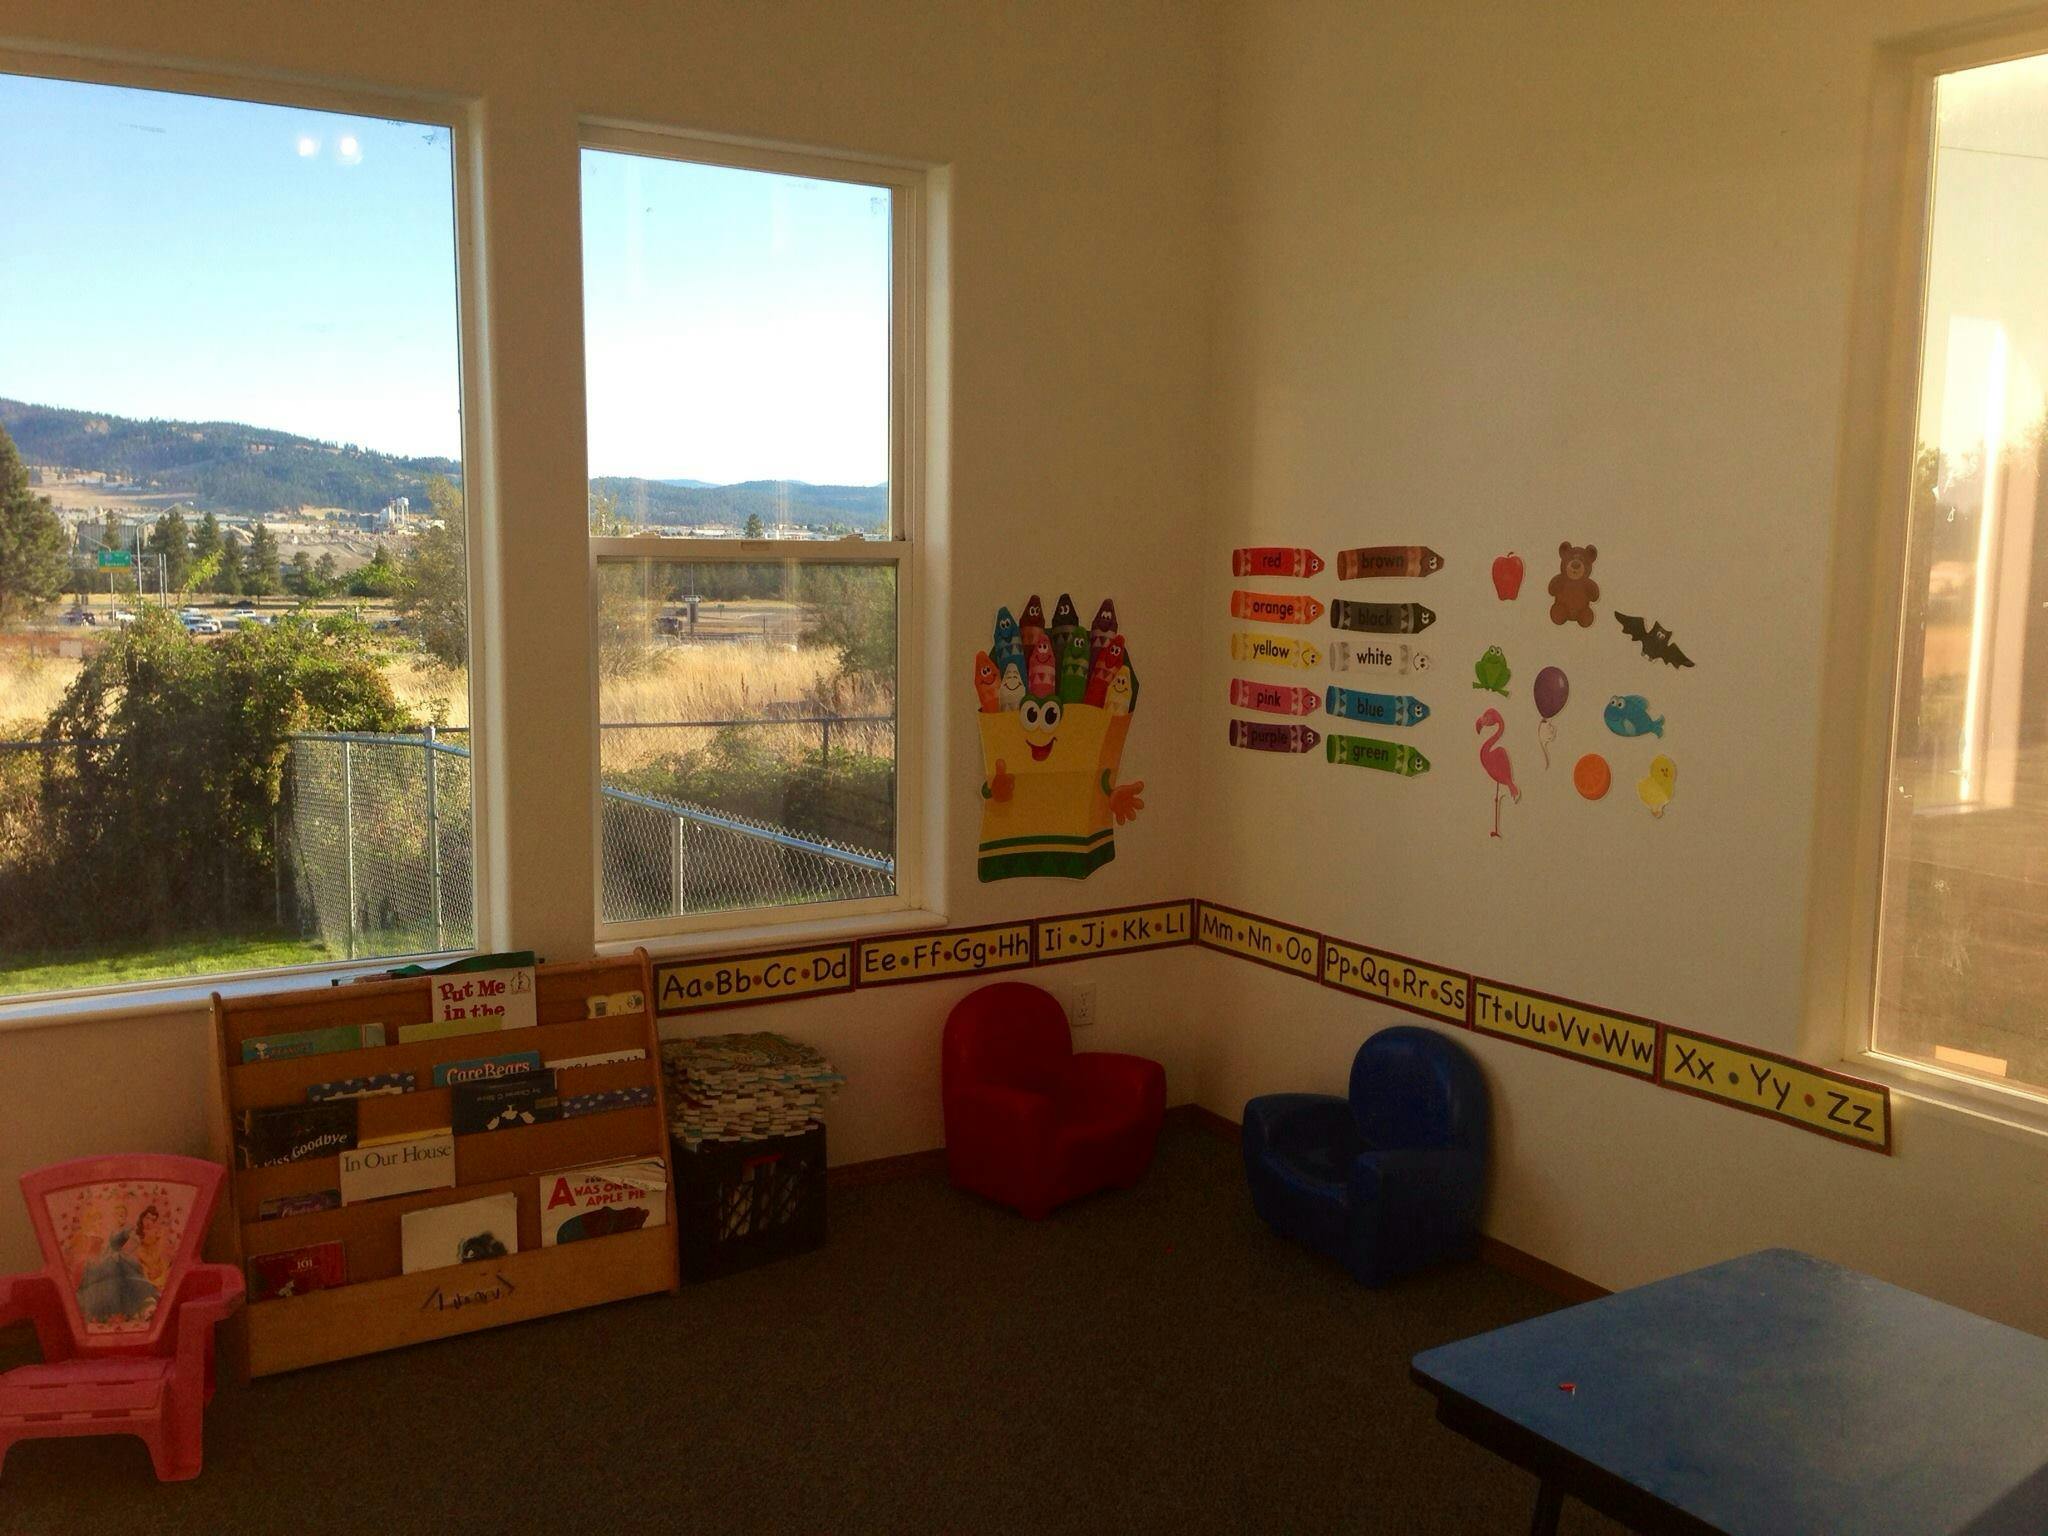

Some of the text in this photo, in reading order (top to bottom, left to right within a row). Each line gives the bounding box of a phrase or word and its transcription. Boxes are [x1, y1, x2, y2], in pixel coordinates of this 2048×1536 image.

[1263, 551, 1282, 568] red
[1361, 552, 1405, 570] brown
[1252, 600, 1294, 621] orange
[1358, 607, 1393, 626] black
[1253, 639, 1291, 660] yellow
[1356, 647, 1393, 666] white
[1256, 688, 1282, 708] pink
[1357, 696, 1385, 718] blue
[1250, 728, 1289, 748] purple
[1352, 744, 1389, 763] green
[1045, 912, 1185, 951] Ii Jj Kk Ll
[1202, 912, 1312, 965] Mm Nn Oo
[864, 932, 1029, 973] Ee Ff Gg Hh
[662, 953, 847, 1001] Aa Bb Cc Dd
[1326, 946, 1465, 1010] Pp Qq Rr Ss
[438, 979, 506, 1003] Put Me
[443, 1003, 506, 1021] in the
[1477, 991, 1654, 1064] Tt Uu Vv Ww
[1673, 1043, 1875, 1133] Xx Yy Zz
[291, 1132, 348, 1159] Goodbye
[344, 1143, 452, 1173] In Our House
[547, 1176, 577, 1210] A
[574, 1184, 601, 1196] WAS
[586, 1189, 647, 1207] APPLE PIE
